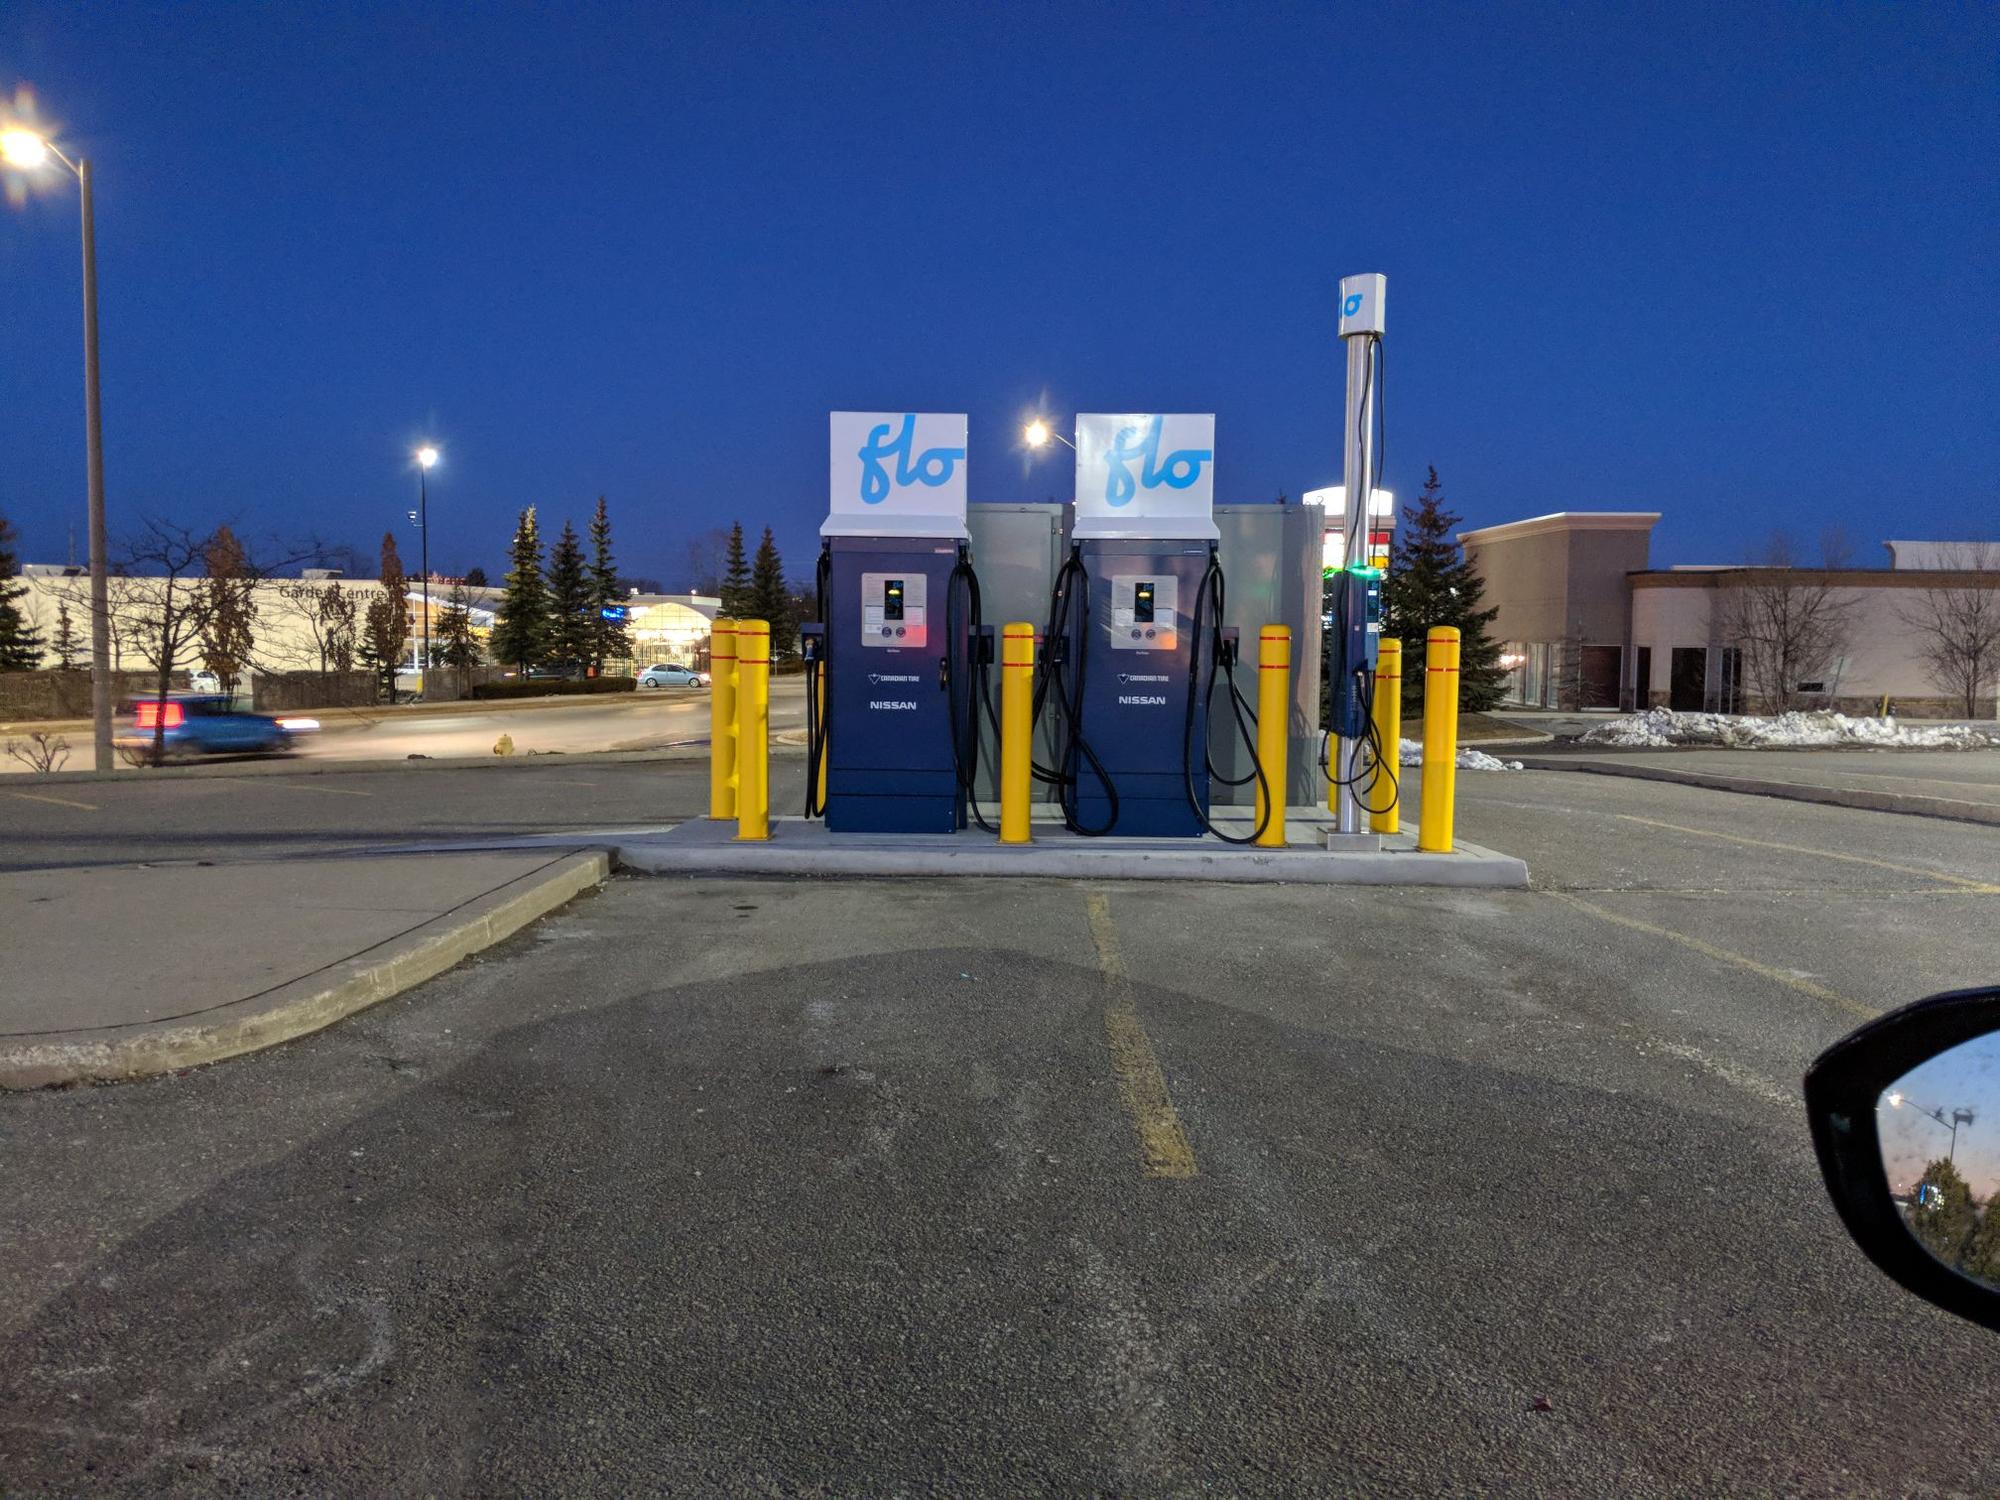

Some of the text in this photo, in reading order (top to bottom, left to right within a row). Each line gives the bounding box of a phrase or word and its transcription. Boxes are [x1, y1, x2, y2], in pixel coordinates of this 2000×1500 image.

[858, 414, 965, 504] flo
[1103, 415, 1212, 507] flo
[280, 586, 332, 599] Garde
[870, 701, 917, 710] NISSAN
[1118, 696, 1166, 705] NISSAN
